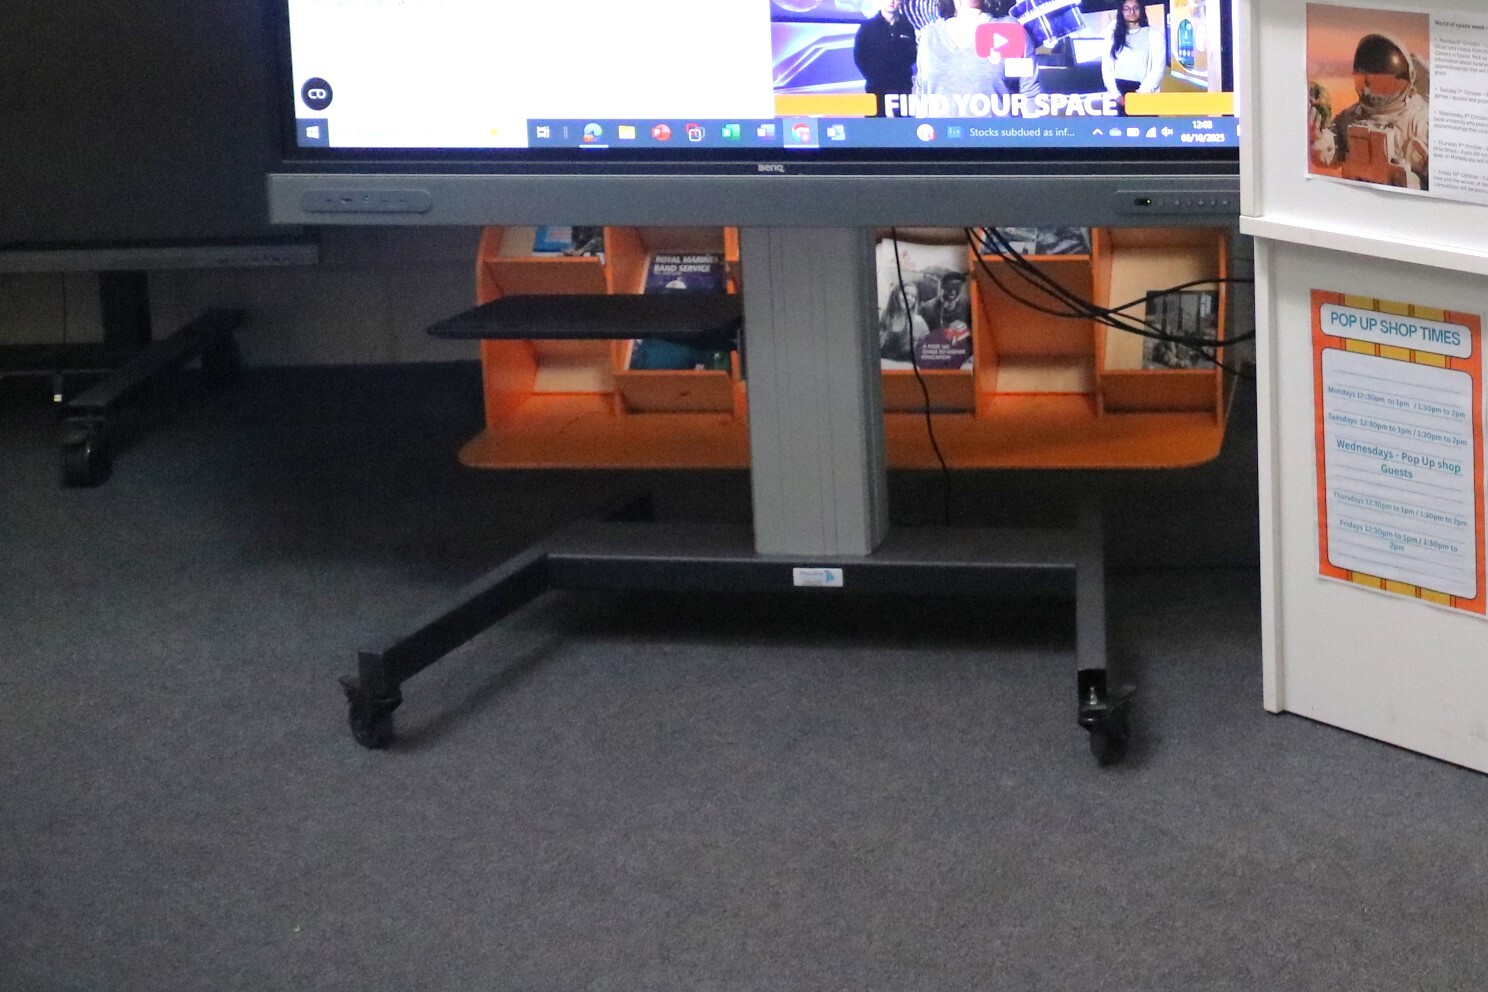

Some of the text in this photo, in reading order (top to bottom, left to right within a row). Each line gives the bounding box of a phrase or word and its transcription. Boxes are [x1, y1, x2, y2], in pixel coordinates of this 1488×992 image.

[884, 93, 1119, 117] FIND YOUR SPACE
[969, 127, 999, 137] Stocks
[1001, 127, 1040, 137] subdued
[1043, 129, 1054, 137] as
[1331, 312, 1461, 346] POP UP SHOP TIMES
[1337, 439, 1460, 475] Wednesdays Pop Up shop
[1381, 464, 1413, 478] Guests
